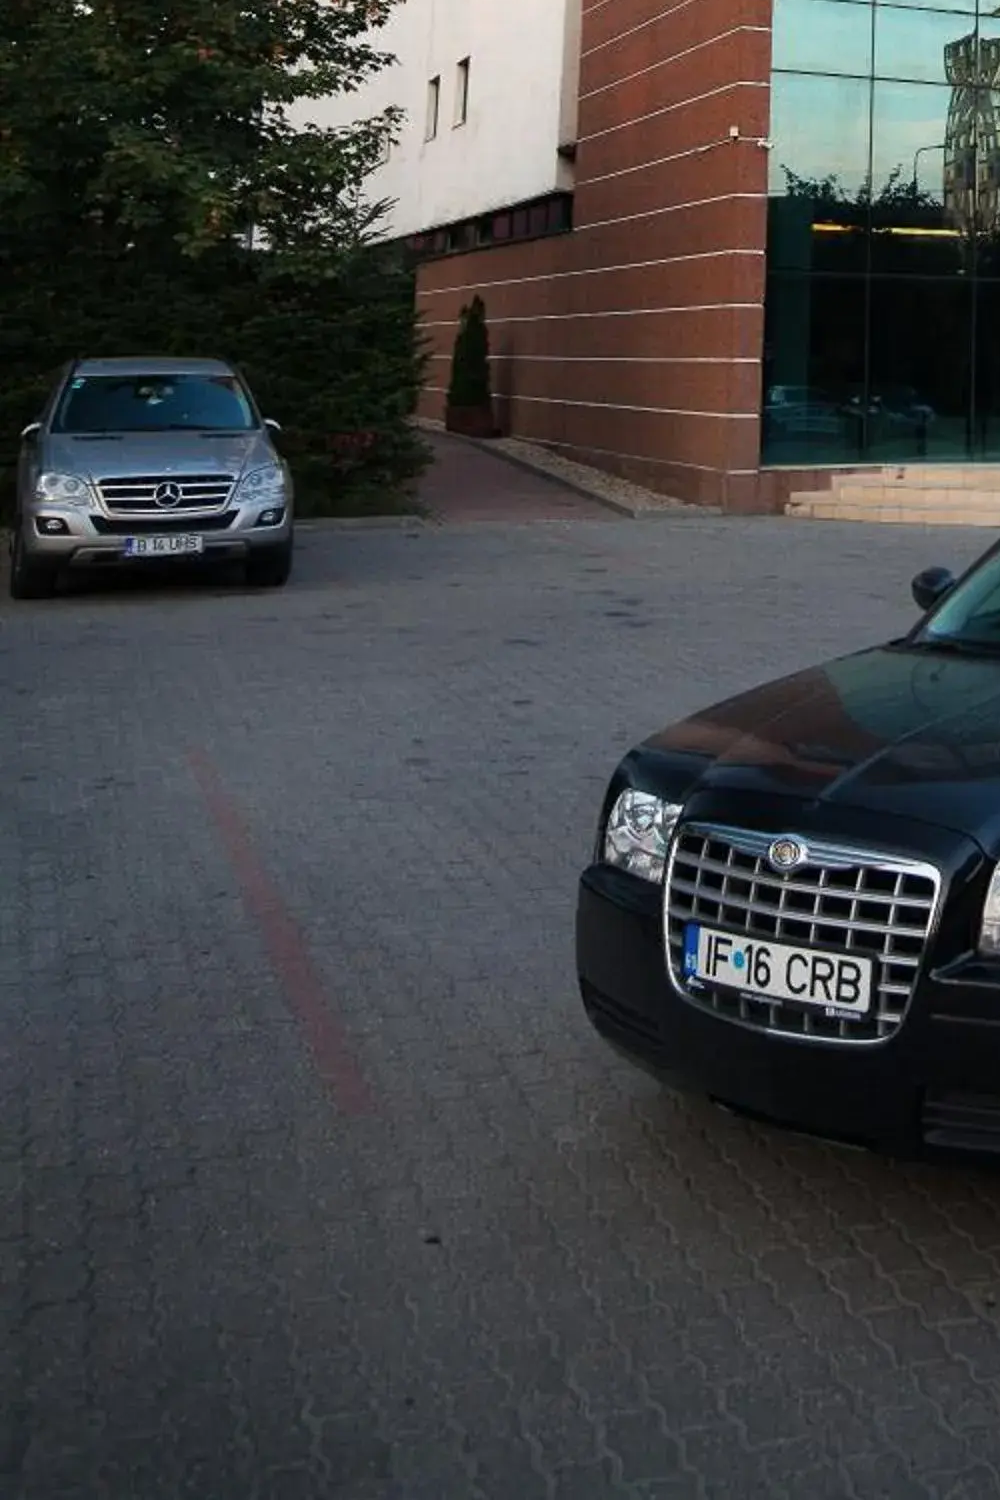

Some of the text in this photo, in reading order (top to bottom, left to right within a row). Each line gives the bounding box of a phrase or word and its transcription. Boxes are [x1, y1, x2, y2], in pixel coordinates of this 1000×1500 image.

[705, 935, 733, 977] IF
[744, 944, 772, 989] 16
[785, 953, 862, 1004] CRB
